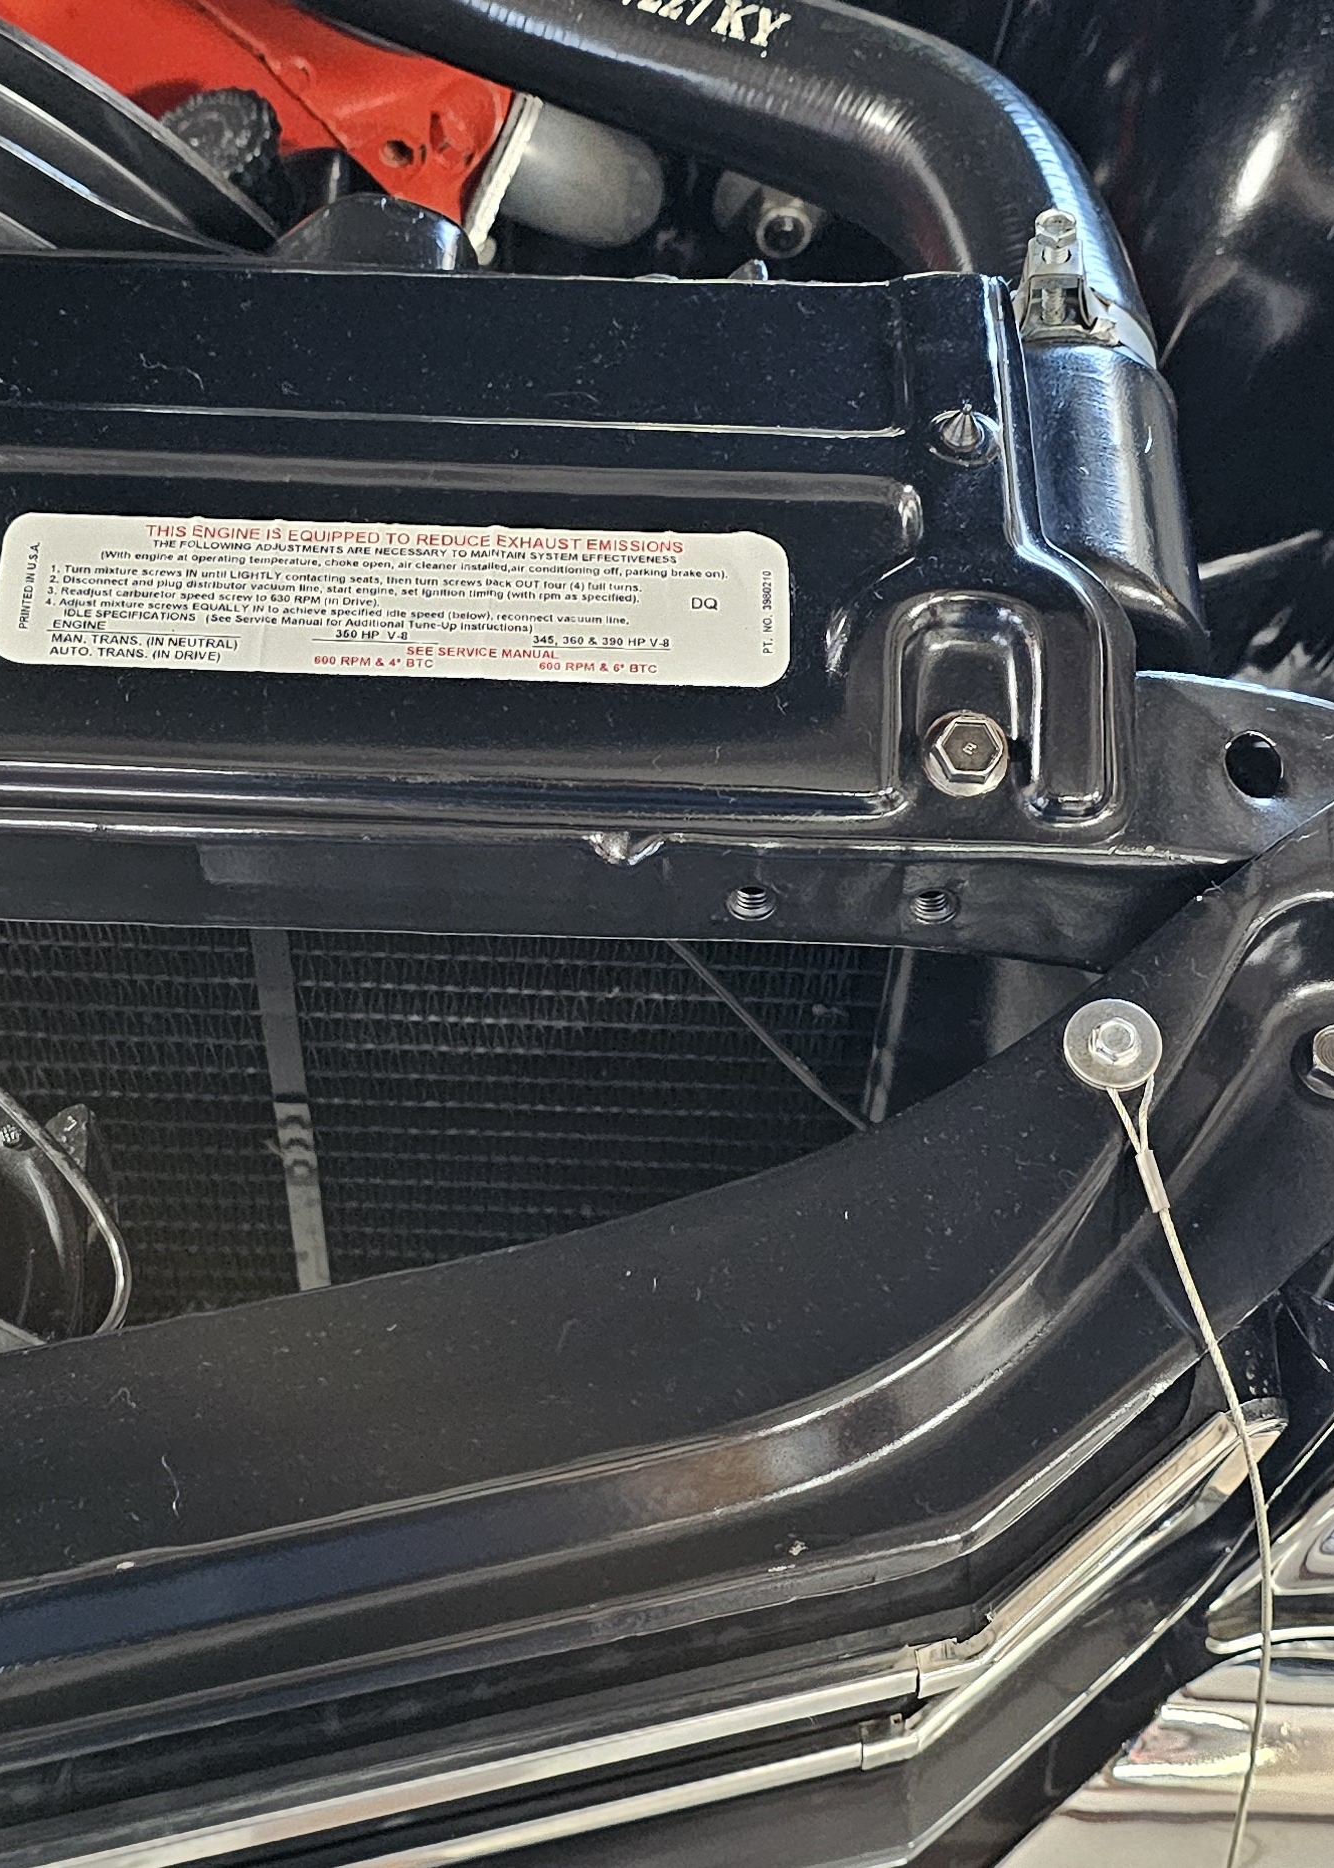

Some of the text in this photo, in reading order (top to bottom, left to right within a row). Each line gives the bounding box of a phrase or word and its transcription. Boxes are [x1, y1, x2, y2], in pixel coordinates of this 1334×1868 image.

[145, 524, 683, 553] THIS ENGINE IS EQUIPPED TO REDUCE EXHAUST EMISSIONS
[153, 539, 676, 563] THE FOLLOWING ADJUSTMENTS ARE NECESSARY TO MAINTAIN SYSTEM EFFECTIVENESS
[101, 550, 131, 560] (With
[134, 553, 173, 561] engine
[191, 554, 245, 565] operating
[249, 555, 321, 567] temperature,
[324, 558, 358, 566] choke
[362, 560, 394, 569] open,
[415, 561, 455, 569] cleaner
[528, 565, 600, 576] conditioning
[603, 567, 622, 576] off,
[625, 568, 667, 578] parking
[671, 568, 702, 577] brake
[705, 570, 727, 579] on).
[25, 572, 35, 583] IN
[51, 564, 60, 572] 1.
[65, 564, 90, 573] Turn
[94, 566, 138, 575] mixture
[142, 569, 182, 577] screws
[185, 569, 197, 577] IN
[201, 570, 226, 578] until
[230, 570, 281, 580] LIGHTLY
[285, 573, 345, 584] contacting
[350, 575, 382, 585] seats,
[386, 576, 411, 584] then
[415, 577, 438, 585] turn
[485, 578, 511, 587] back
[515, 580, 538, 588] OUT
[543, 581, 566, 589] four
[569, 582, 584, 591] (4)
[588, 582, 605, 590] full
[609, 583, 642, 592] turns.
[47, 586, 56, 594] 3.
[60, 586, 112, 598] Readjust
[116, 589, 175, 598] carburetor
[180, 592, 214, 601] speed
[256, 594, 267, 602] to
[294, 595, 320, 604] RPM
[49, 574, 58, 583] 2.
[63, 575, 128, 585] Disconnect
[131, 578, 153, 586] and
[156, 579, 182, 589] plug
[186, 580, 246, 589] distributor
[250, 583, 295, 591] vacuum
[299, 584, 322, 593] line,
[326, 585, 351, 593] start
[355, 587, 397, 596] engine,
[421, 588, 465, 597] ignition
[469, 589, 503, 599] timing
[507, 590, 535, 600] (with
[539, 593, 560, 601] rpm
[582, 593, 639, 604] specified).
[18, 585, 34, 630] PRINTED
[59, 598, 96, 607] Adjust
[100, 600, 144, 608] mixture
[148, 602, 188, 610] screws
[192, 602, 249, 612] EQUALLY
[268, 605, 279, 613] to
[282, 606, 326, 615] achieve
[330, 608, 382, 616] specified
[386, 609, 406, 618] idle
[411, 611, 444, 619] speed
[448, 611, 493, 620] (below),
[496, 614, 552, 622] reconnect
[691, 597, 717, 610] DQ
[762, 570, 774, 654] PT. NO. 3980210
[52, 619, 106, 630] ENGINE
[63, 608, 91, 617] IDLE
[95, 609, 195, 621] SPECIFICATIONS
[205, 613, 231, 623] (See
[235, 615, 277, 624] Service
[281, 616, 322, 626] Manual
[326, 618, 341, 626] for
[344, 618, 404, 628] Additional
[409, 620, 457, 631] Tune-Up
[51, 633, 237, 650] MAN. TRANS. (IN NEUTRAL)
[361, 630, 379, 639] HP
[387, 631, 407, 640] V-8
[533, 635, 669, 647] 345, 360 & 390 HP V-8
[49, 646, 220, 662] AUTO. TRANS. (IN DRIVE)
[406, 646, 558, 658] SEE SERVICE MANUAL
[314, 655, 336, 664] 600
[340, 656, 370, 666] RPM
[375, 657, 384, 666] &
[406, 658, 432, 668] BTC
[539, 662, 560, 670] 600
[565, 662, 594, 670] RPM
[599, 662, 608, 671] &
[629, 663, 656, 673] BTC
